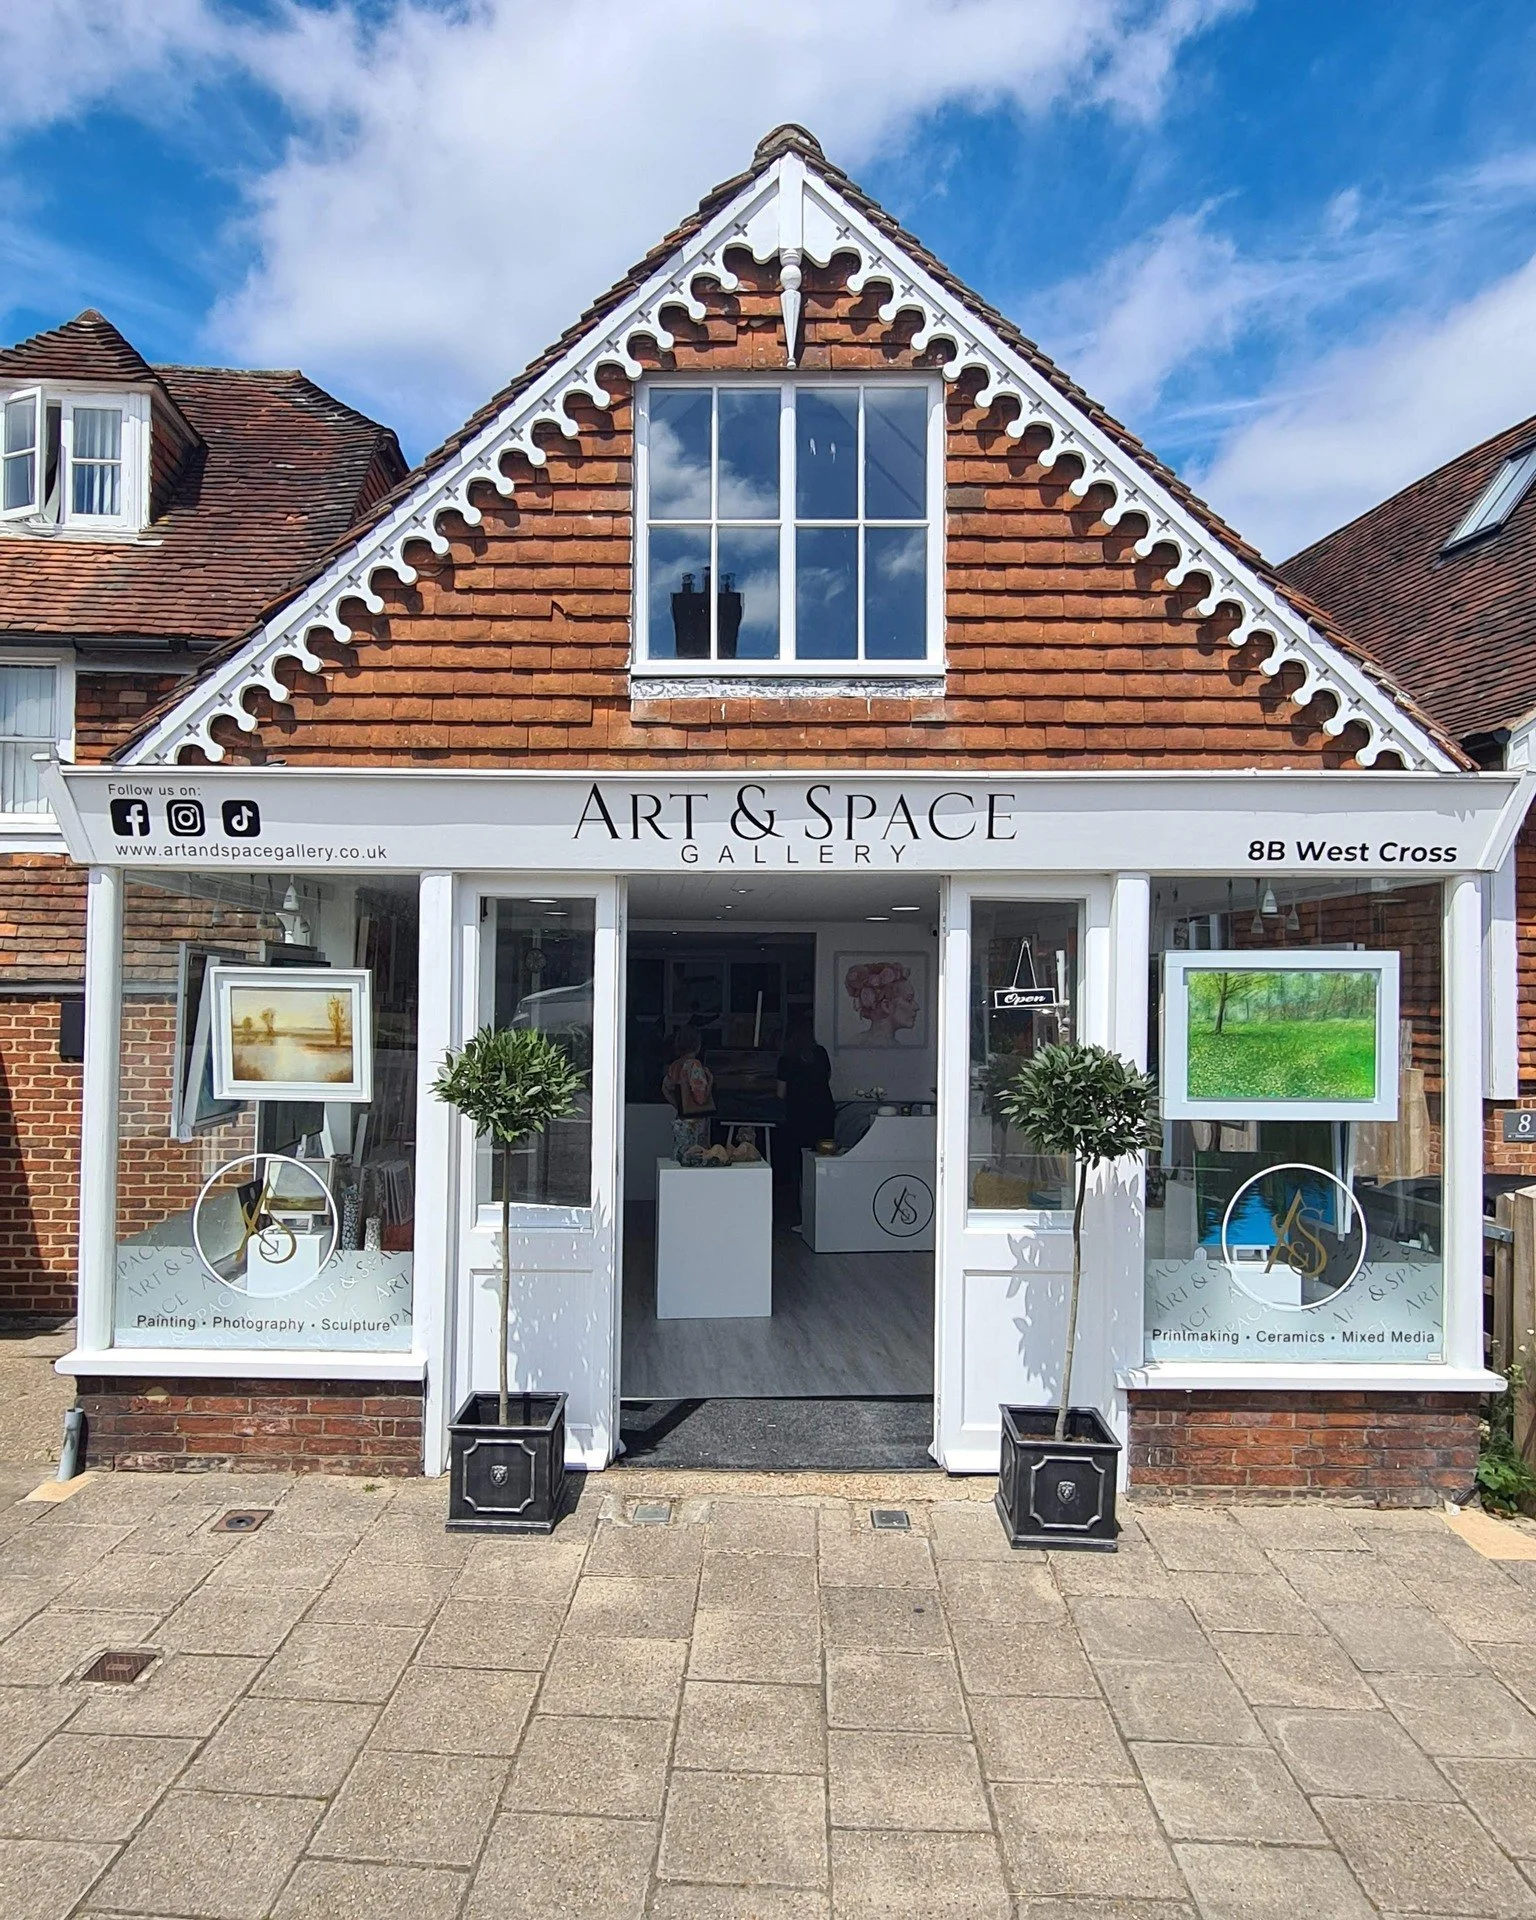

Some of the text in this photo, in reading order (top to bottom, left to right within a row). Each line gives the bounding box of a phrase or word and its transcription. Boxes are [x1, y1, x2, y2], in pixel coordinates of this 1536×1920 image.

[107, 783, 201, 796] Follow us on:
[572, 783, 1018, 841] ART & SPACE
[115, 843, 387, 862] www.artandspacegallery.co.uk
[681, 844, 906, 864] GALLERY
[1247, 840, 1458, 862] 8B West Cross
[1004, 993, 1045, 1005] Open
[1518, 1114, 1531, 1132] 8
[137, 1314, 391, 1333] Painting Photography Sculpture
[1152, 1328, 1240, 1345] Printmaking
[1256, 1329, 1326, 1344] Ceramics
[1342, 1330, 1385, 1344] Mixed
[1391, 1330, 1436, 1344] Media
